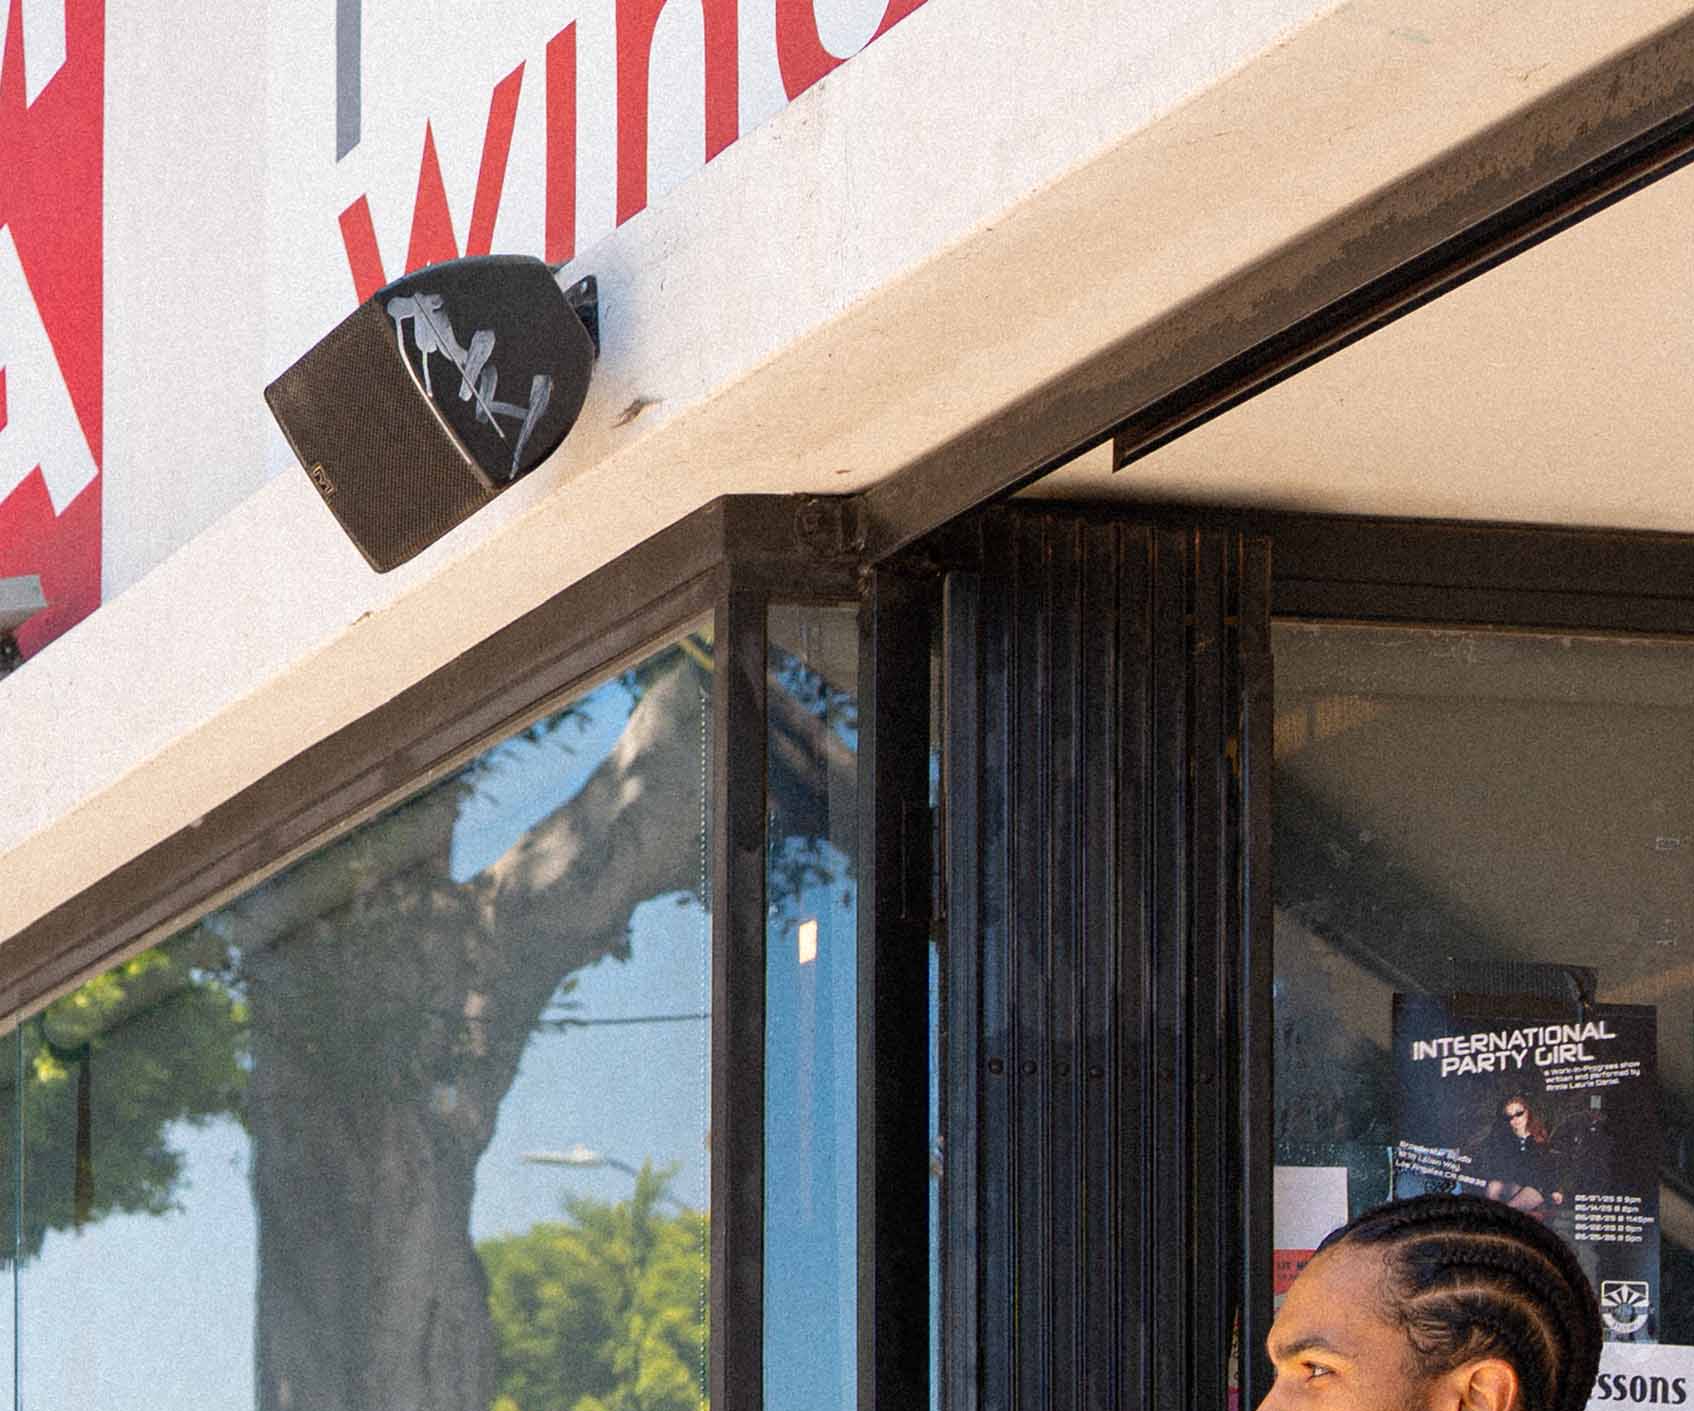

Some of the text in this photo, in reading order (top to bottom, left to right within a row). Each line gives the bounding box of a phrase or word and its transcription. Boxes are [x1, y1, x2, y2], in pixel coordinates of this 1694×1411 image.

[1412, 1021, 1617, 1061] INTERNATIONAL
[1440, 1047, 1529, 1078] PARTY
[1534, 1043, 1595, 1066] GIRL
[1597, 1373, 1687, 1405] ssons
